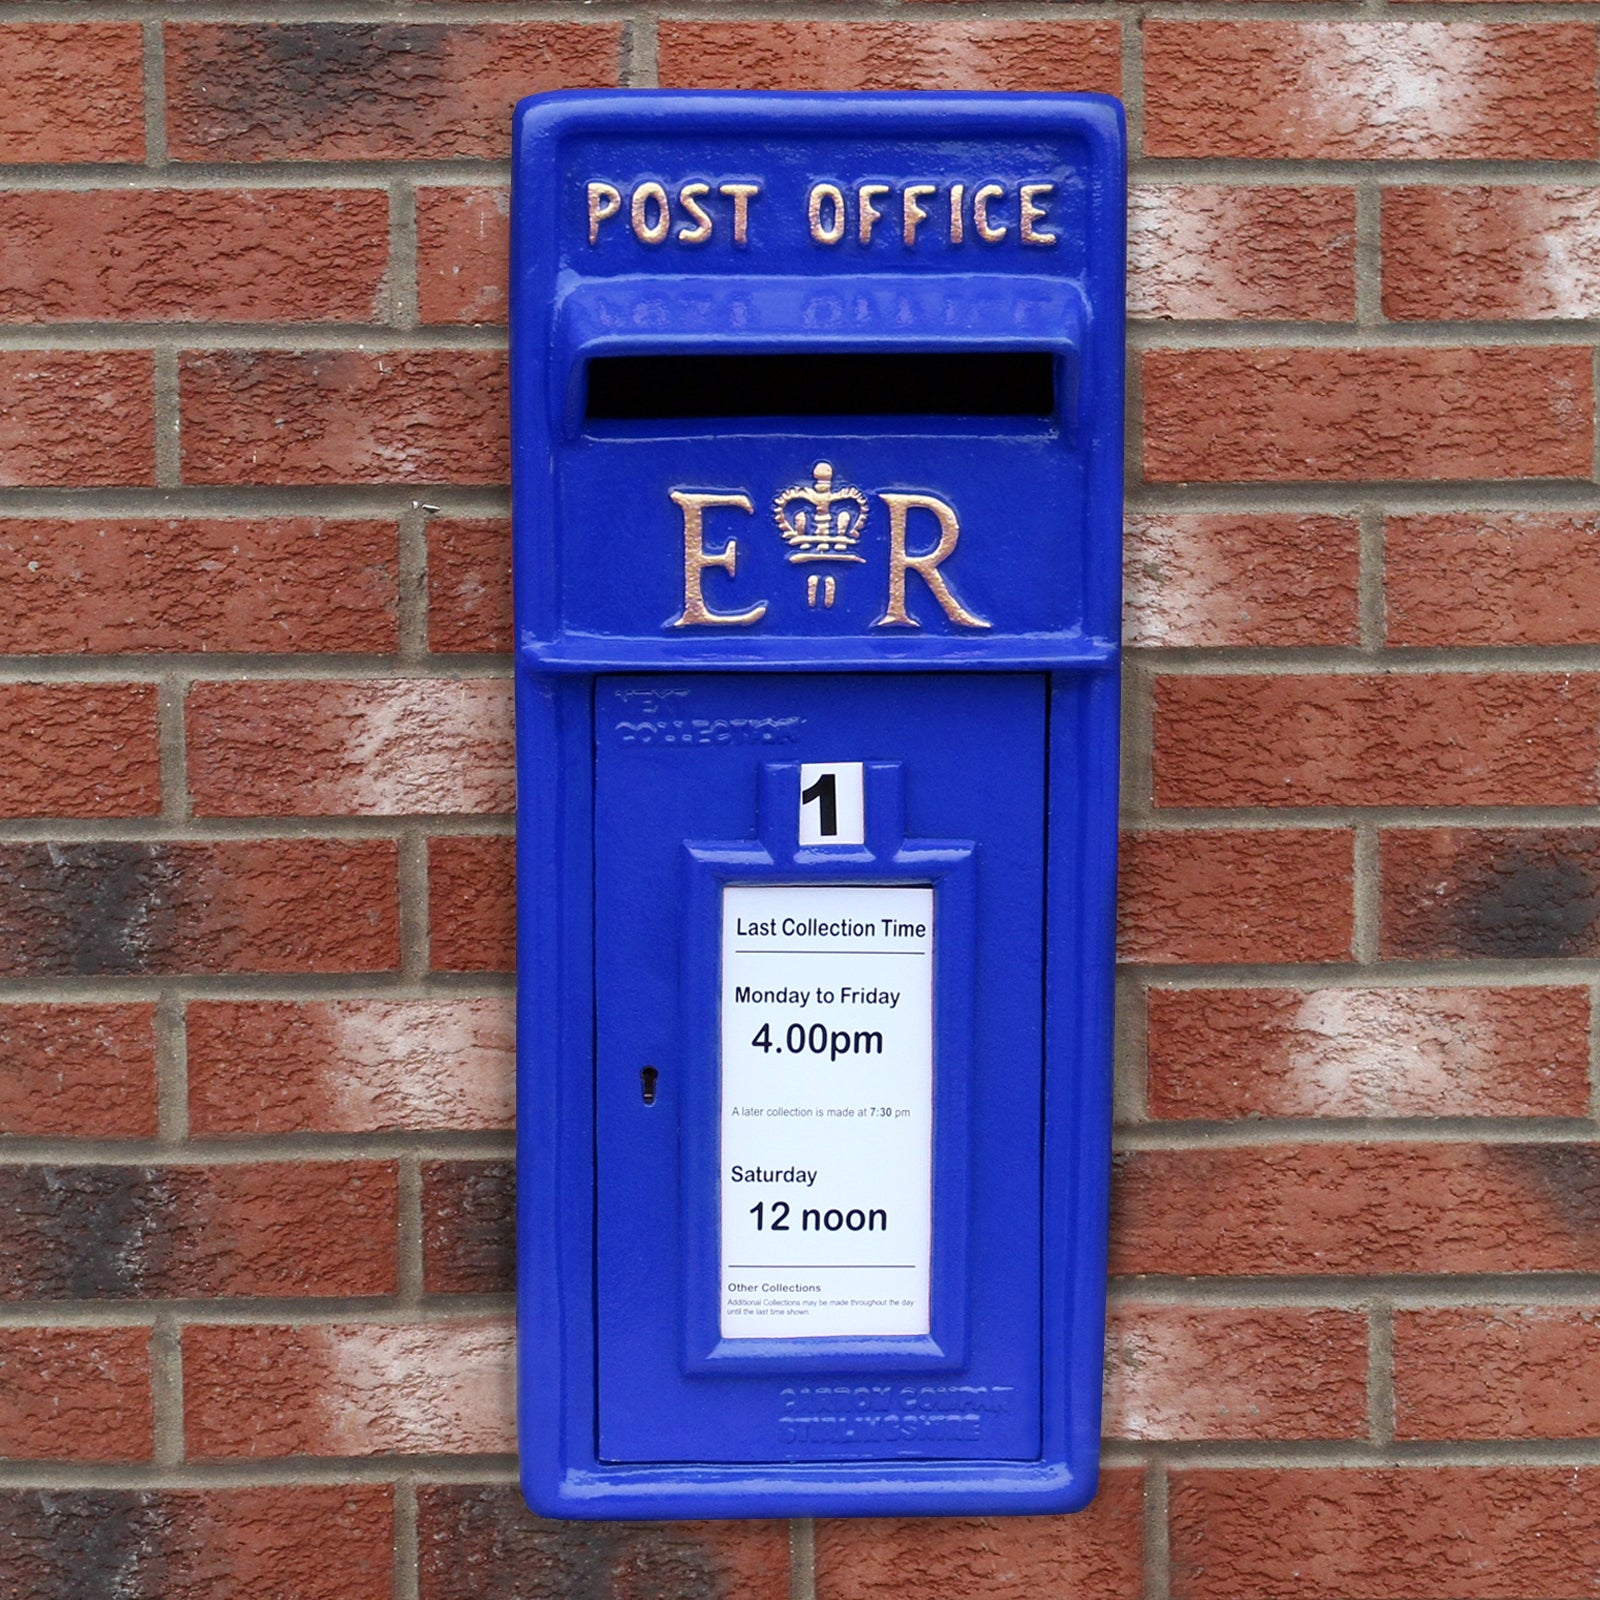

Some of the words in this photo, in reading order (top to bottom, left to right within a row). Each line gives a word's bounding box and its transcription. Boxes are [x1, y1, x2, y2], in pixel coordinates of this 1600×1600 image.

[587, 182, 758, 245] POST
[807, 183, 1056, 245] OFFICE
[802, 774, 837, 836] 1
[737, 918, 776, 936] Last
[782, 918, 875, 936] Collection
[881, 919, 926, 937] Time
[736, 987, 810, 1008] Monday
[816, 988, 834, 1003] to
[841, 987, 900, 1008] Friday
[752, 1023, 882, 1062] 4.00pm
[732, 1107, 740, 1116] A
[742, 1107, 763, 1116] later
[767, 1107, 812, 1117] collection
[816, 1108, 824, 1117] is
[827, 1108, 854, 1117] made
[858, 1108, 867, 1117] at
[870, 1107, 892, 1117] 7:30
[895, 1110, 910, 1119] pm
[732, 1166, 817, 1187] Saturday
[750, 1202, 789, 1231] 12
[803, 1209, 886, 1231] noon
[728, 1283, 758, 1292] Other
[762, 1283, 821, 1292] Collections
